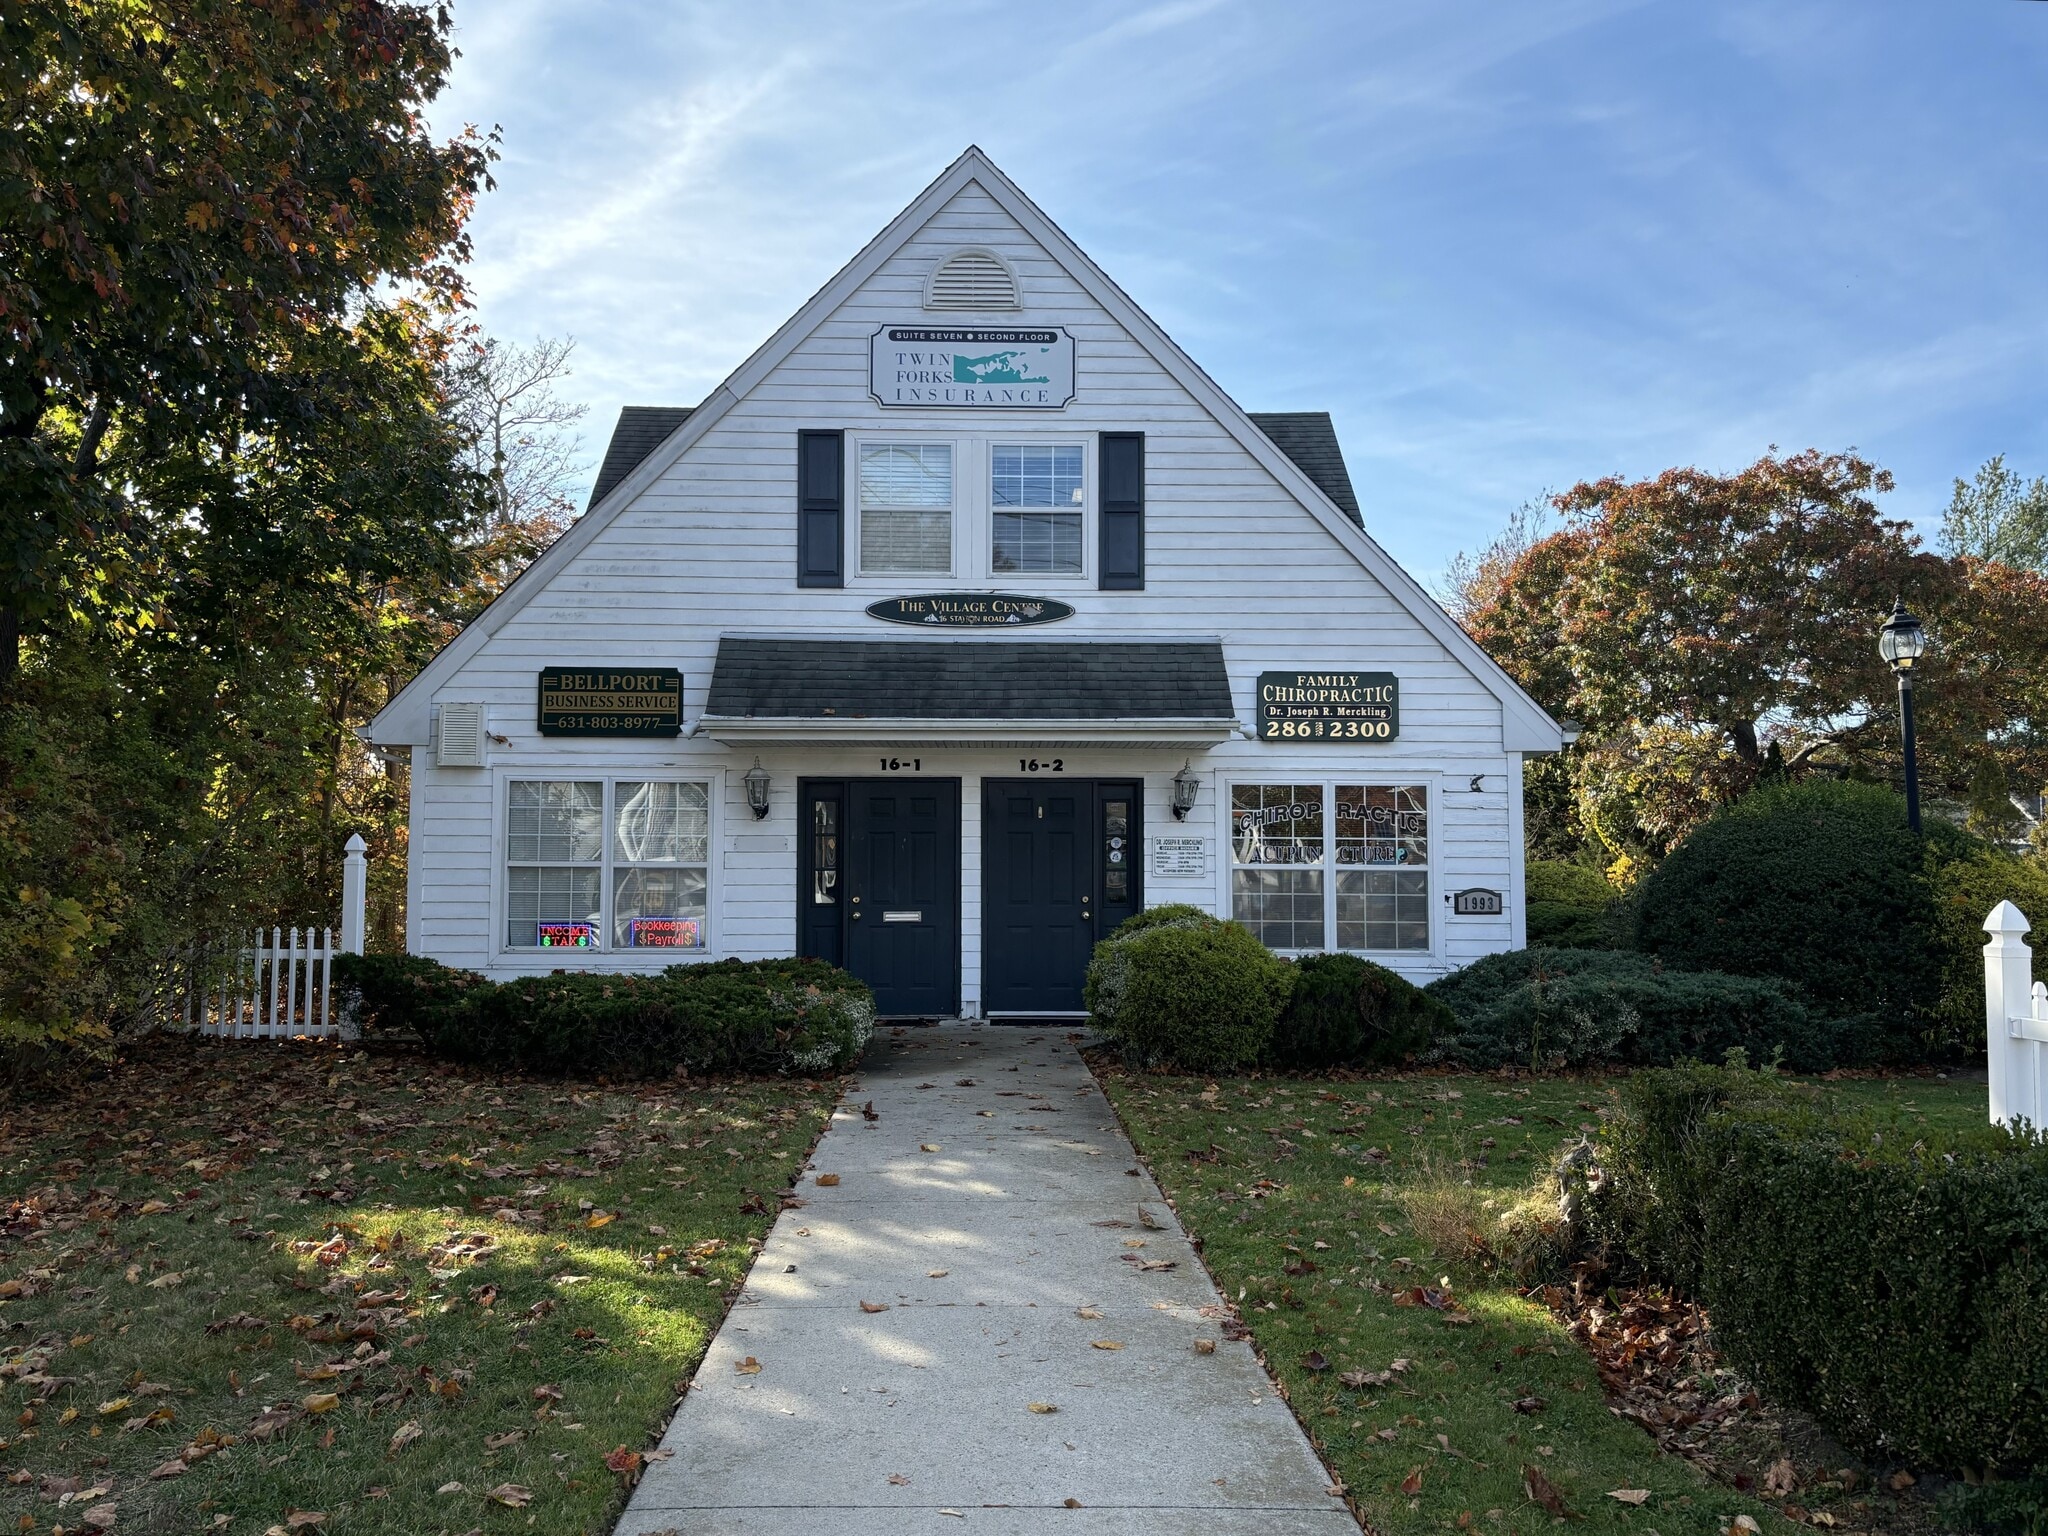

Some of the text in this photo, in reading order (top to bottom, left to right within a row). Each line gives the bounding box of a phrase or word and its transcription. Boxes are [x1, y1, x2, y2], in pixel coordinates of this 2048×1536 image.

[896, 332, 926, 340] SUITE
[896, 353, 951, 365] TWIN
[896, 370, 953, 384] FORKS
[896, 388, 1049, 403] INSURANCE
[898, 600, 926, 612] THE
[930, 600, 987, 613] VILLAGE
[983, 615, 1005, 623] ROAD
[560, 674, 662, 691] BELLPORT
[1297, 675, 1359, 687] FAMILY
[1263, 684, 1393, 703] CHIROPRACTIC
[545, 695, 677, 709] BUSINESS SERVICE
[1269, 706, 1387, 719] Dr. Joseph R. Merckling
[558, 716, 661, 729] 631-803-8977
[1266, 721, 1390, 738] 286 2300
[880, 758, 921, 771] 16-1
[1019, 759, 1064, 772] 16-2
[1464, 896, 1494, 910] 1993
[541, 926, 589, 936] INCOME
[634, 920, 697, 934] Bookkeeping
